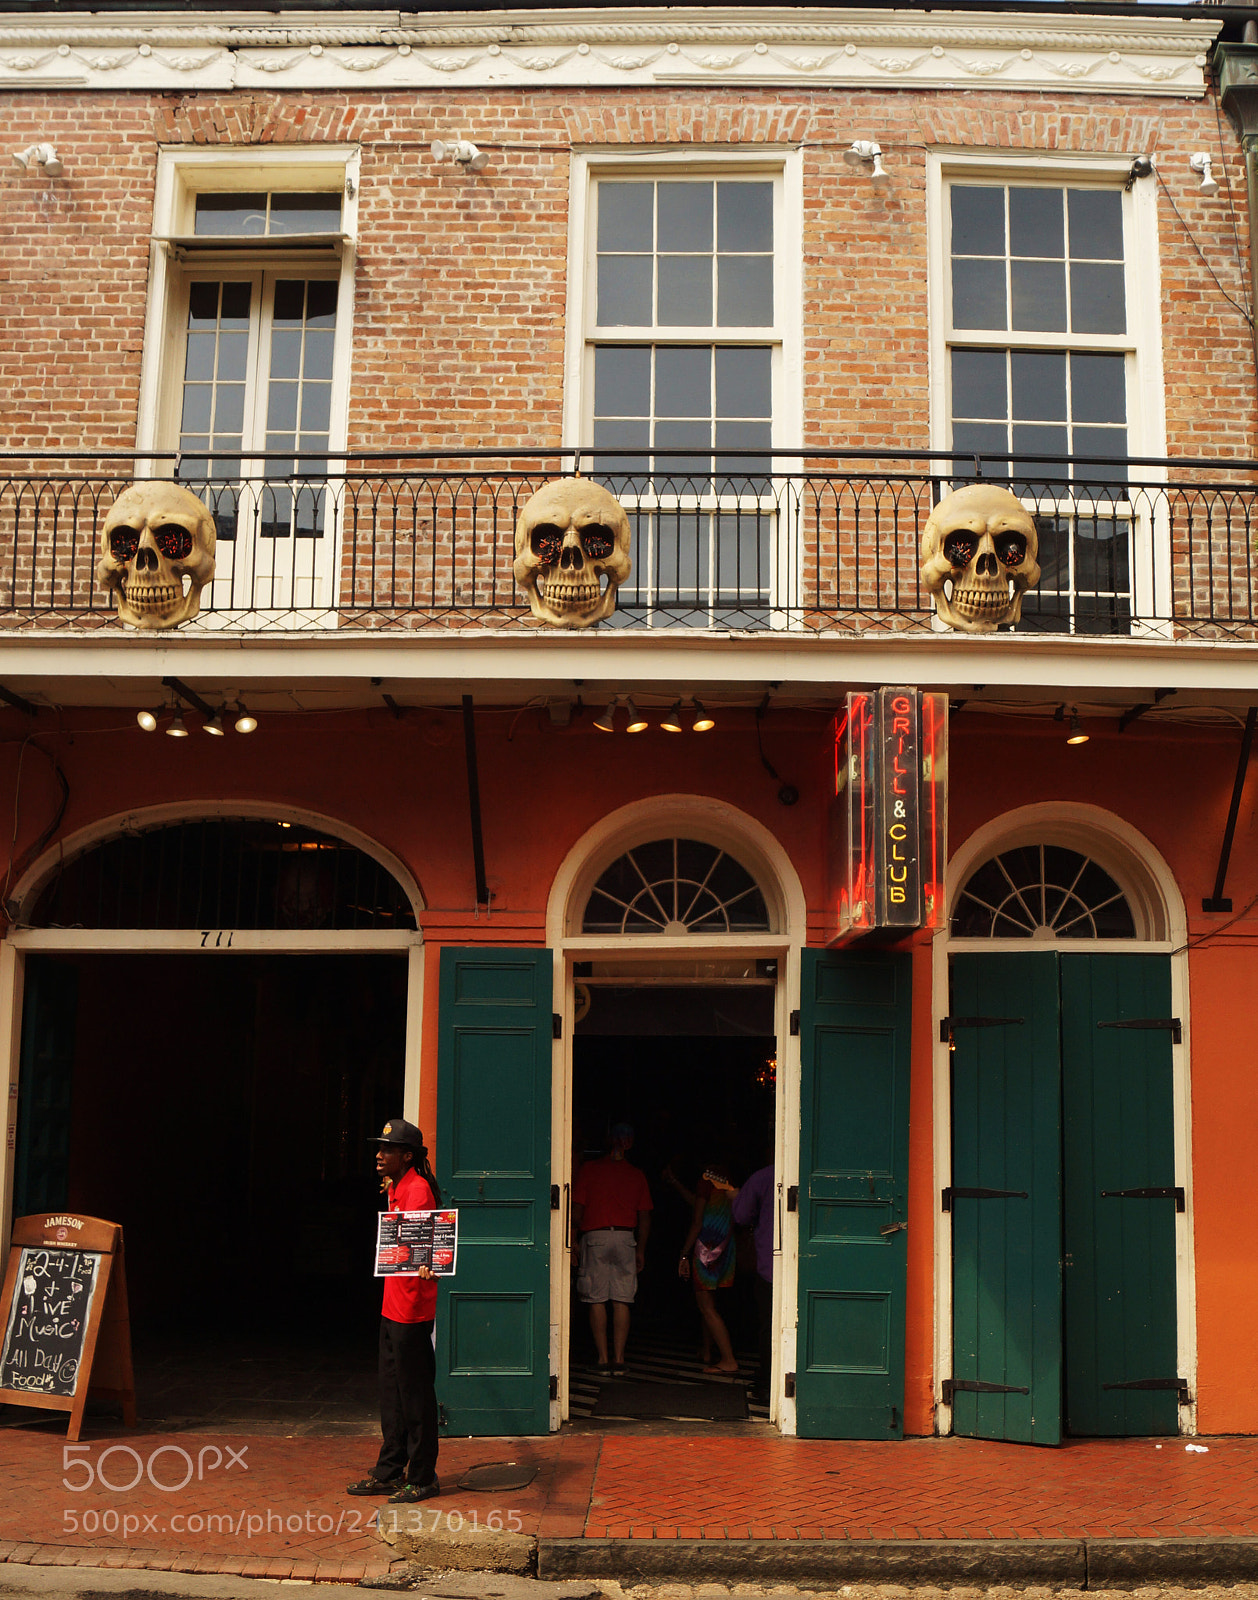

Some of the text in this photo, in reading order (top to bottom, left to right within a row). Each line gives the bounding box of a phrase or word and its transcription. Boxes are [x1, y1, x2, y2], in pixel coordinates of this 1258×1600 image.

[889, 696, 911, 903] GRILL & CLUB
[200, 931, 234, 948] 711
[44, 1216, 84, 1231] JAMESON
[33, 1251, 82, 1281] 2-4-1
